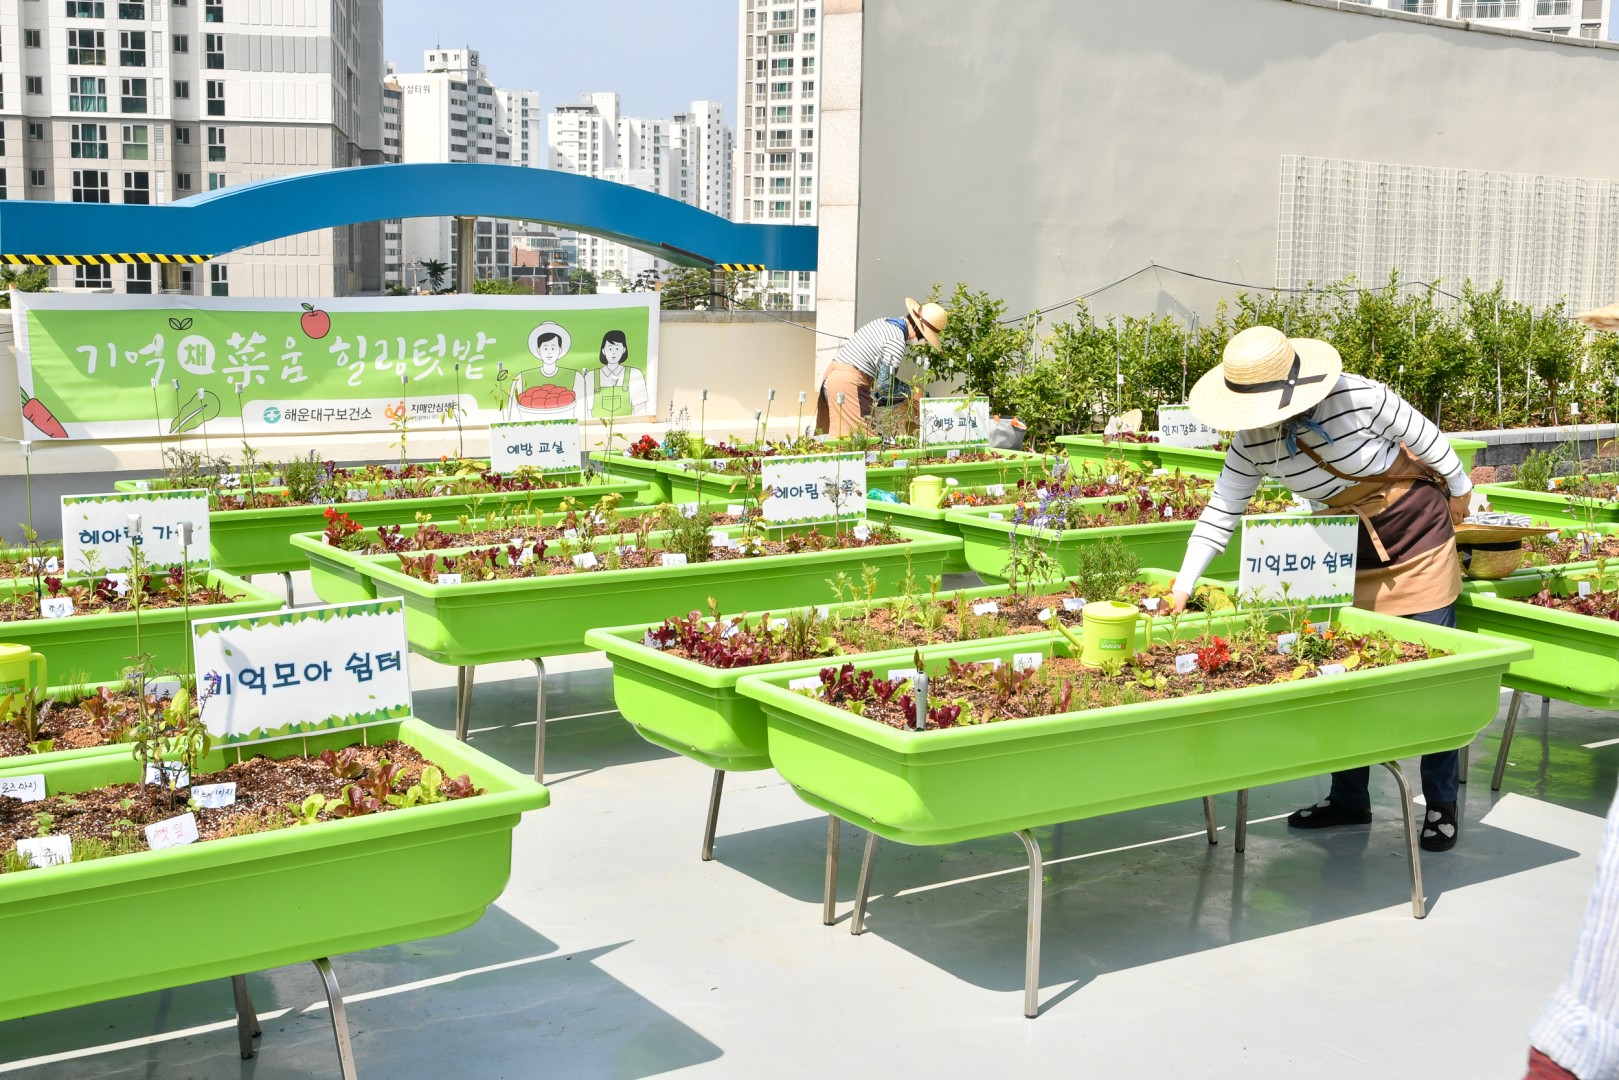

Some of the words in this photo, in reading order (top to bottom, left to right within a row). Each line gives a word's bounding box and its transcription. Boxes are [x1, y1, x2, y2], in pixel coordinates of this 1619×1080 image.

[402, 84, 431, 95] 성타워
[328, 331, 497, 387] 힐링텃밭
[283, 406, 373, 422] 해운대구보건소
[932, 417, 954, 430] 예방
[957, 416, 979, 429] 교실
[1161, 423, 1197, 436] 인지강화
[505, 440, 535, 457] 예방
[537, 438, 565, 456] 교실
[1246, 553, 1317, 577] 기억모아
[1322, 550, 1354, 575] 쉼터
[205, 661, 333, 697] 기억모아
[345, 648, 402, 684] 쉼터
